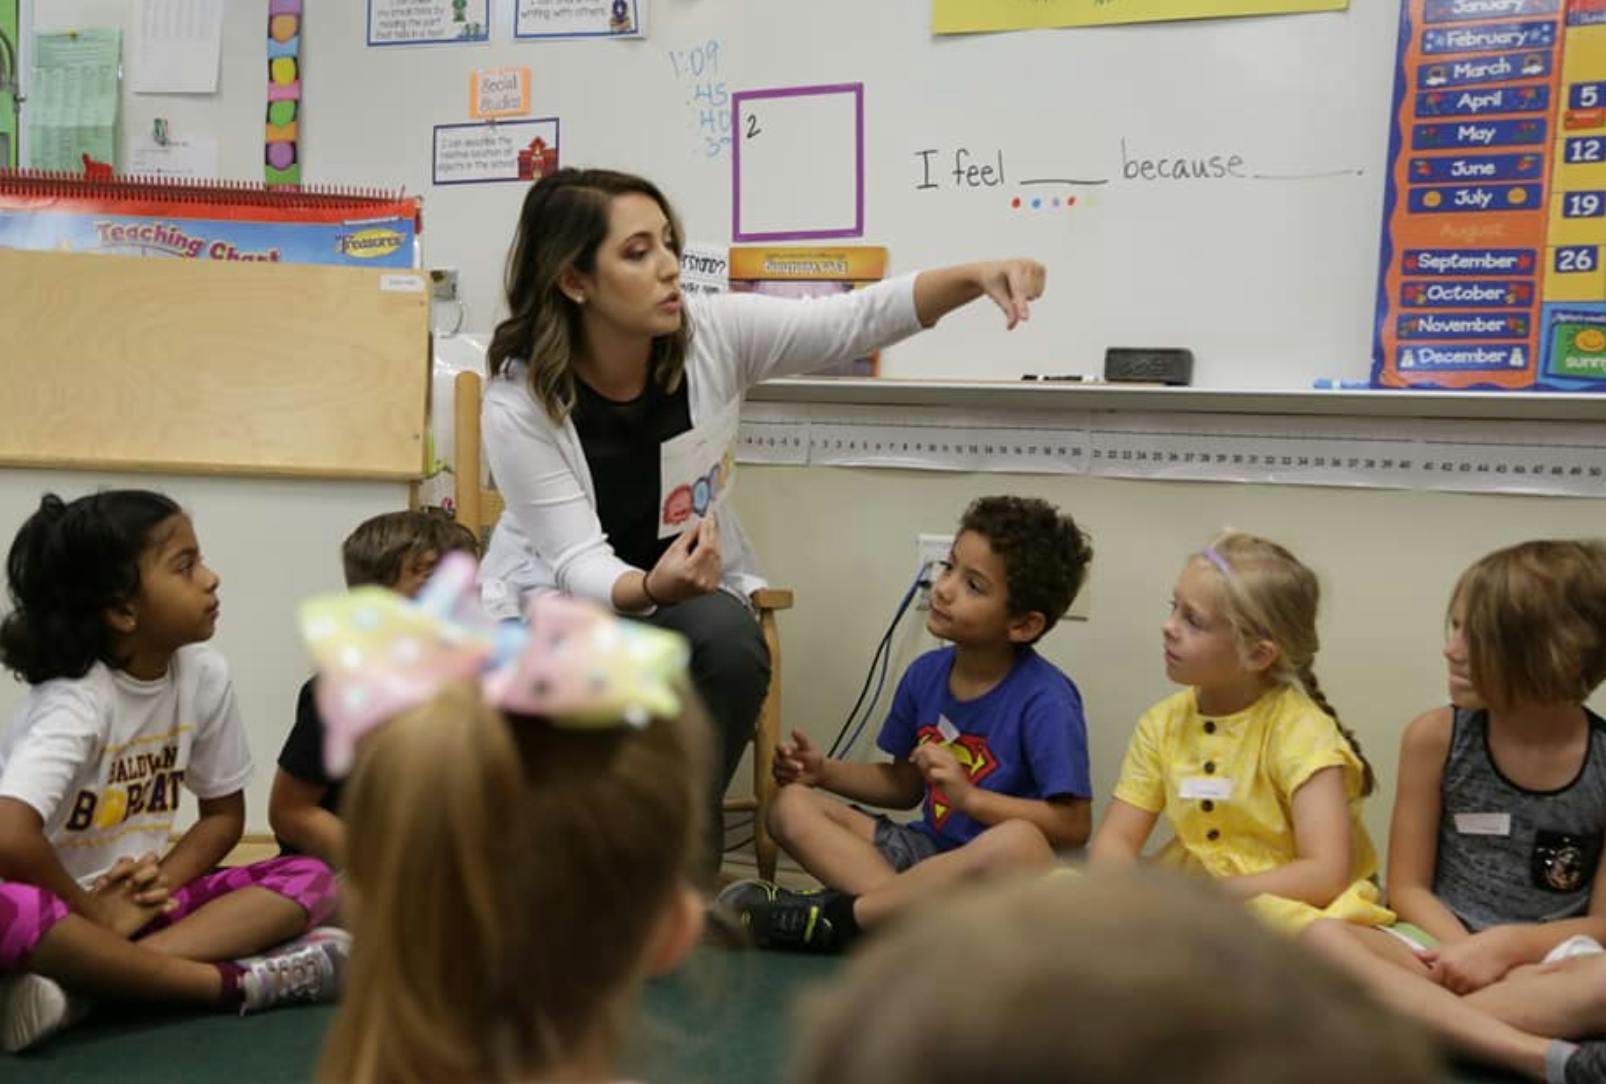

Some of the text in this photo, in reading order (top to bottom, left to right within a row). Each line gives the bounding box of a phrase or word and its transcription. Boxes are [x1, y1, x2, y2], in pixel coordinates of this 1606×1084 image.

[1447, 29, 1527, 47] February
[669, 40, 719, 79] 1:09
[1454, 58, 1511, 78] March
[694, 83, 729, 107] 45
[1457, 91, 1503, 112] April
[1580, 86, 1597, 107] 5
[747, 114, 762, 139] 2
[1457, 126, 1495, 144] May
[1571, 140, 1600, 161] 12
[914, 137, 1245, 189] I feel because
[1451, 161, 1495, 176] June
[1454, 189, 1493, 207] July
[1569, 194, 1600, 215] 19
[94, 221, 204, 258] Teaching
[1418, 253, 1517, 272] September
[1558, 250, 1592, 271] 26
[1427, 284, 1505, 300] October
[1418, 317, 1505, 332] November
[1419, 348, 1506, 363] December
